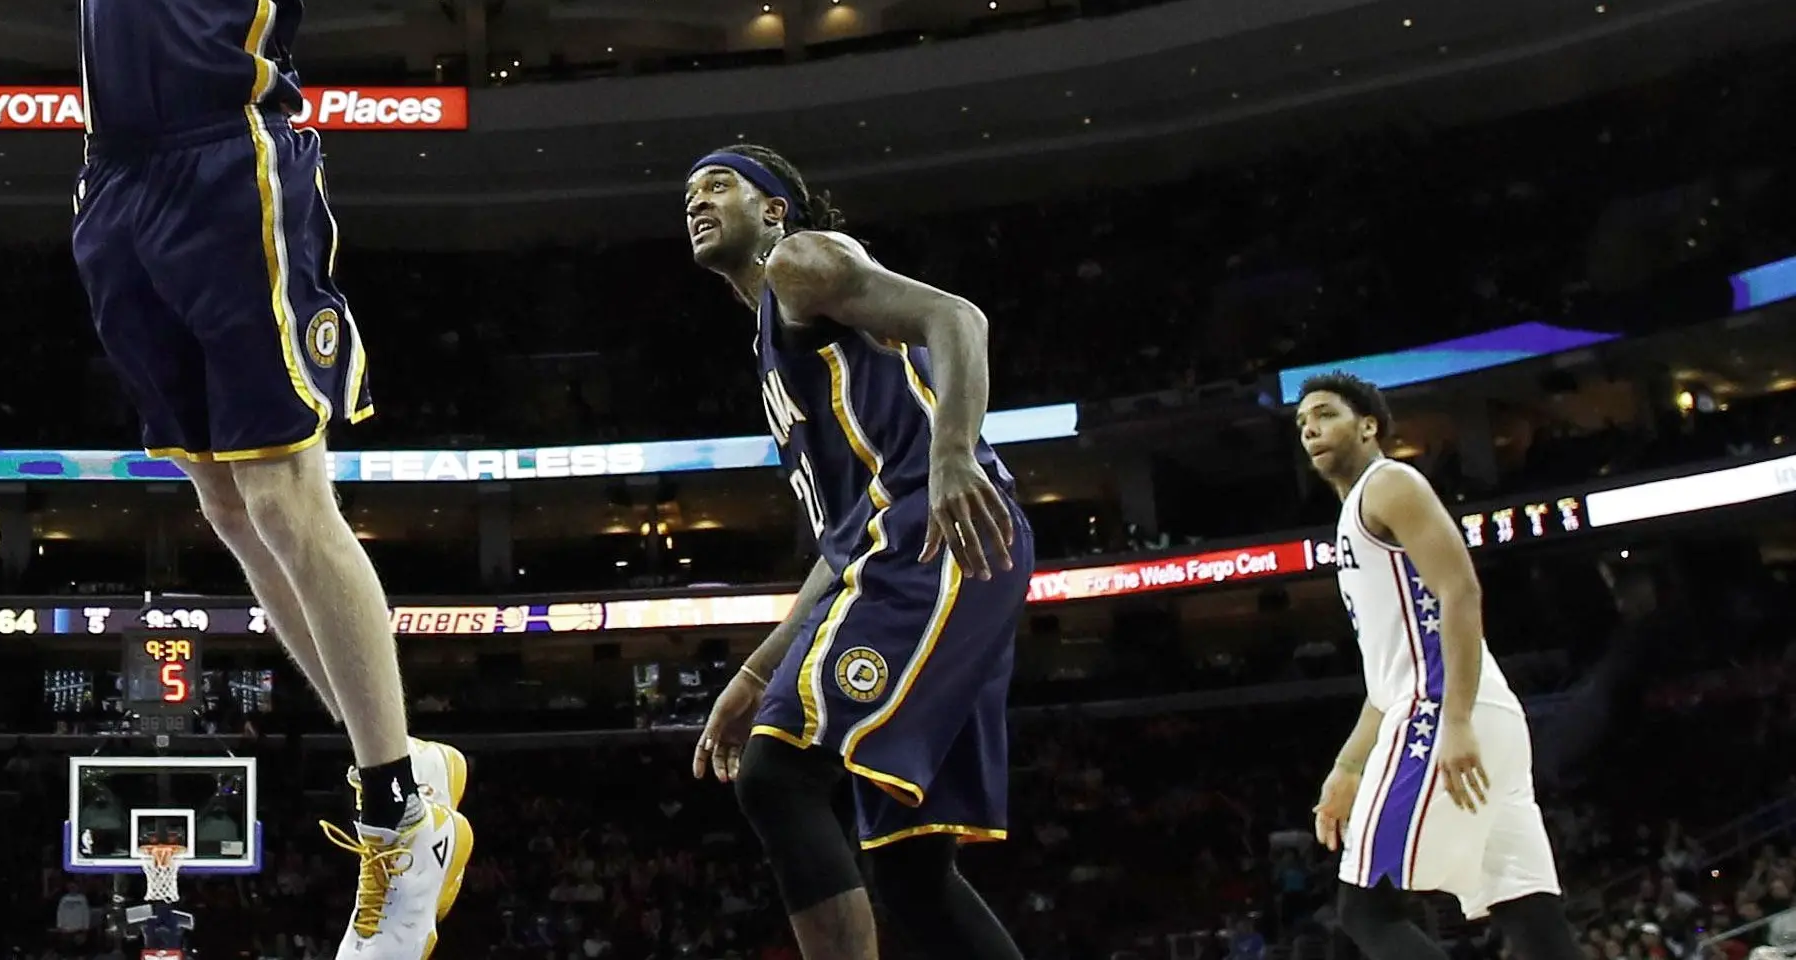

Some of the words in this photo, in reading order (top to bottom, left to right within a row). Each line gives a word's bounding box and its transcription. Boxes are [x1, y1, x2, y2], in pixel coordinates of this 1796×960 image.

[318, 90, 443, 123] Places
[360, 444, 645, 481] FEARLESS
[1083, 575, 1112, 593] For
[1114, 571, 1139, 590] the
[1140, 564, 1185, 586] Wells
[1186, 558, 1234, 582] Fargo
[1236, 551, 1277, 573] Cent
[89, 616, 105, 633] 5
[390, 609, 488, 634] acers
[146, 640, 191, 662] 9:39
[162, 662, 187, 701] 5
